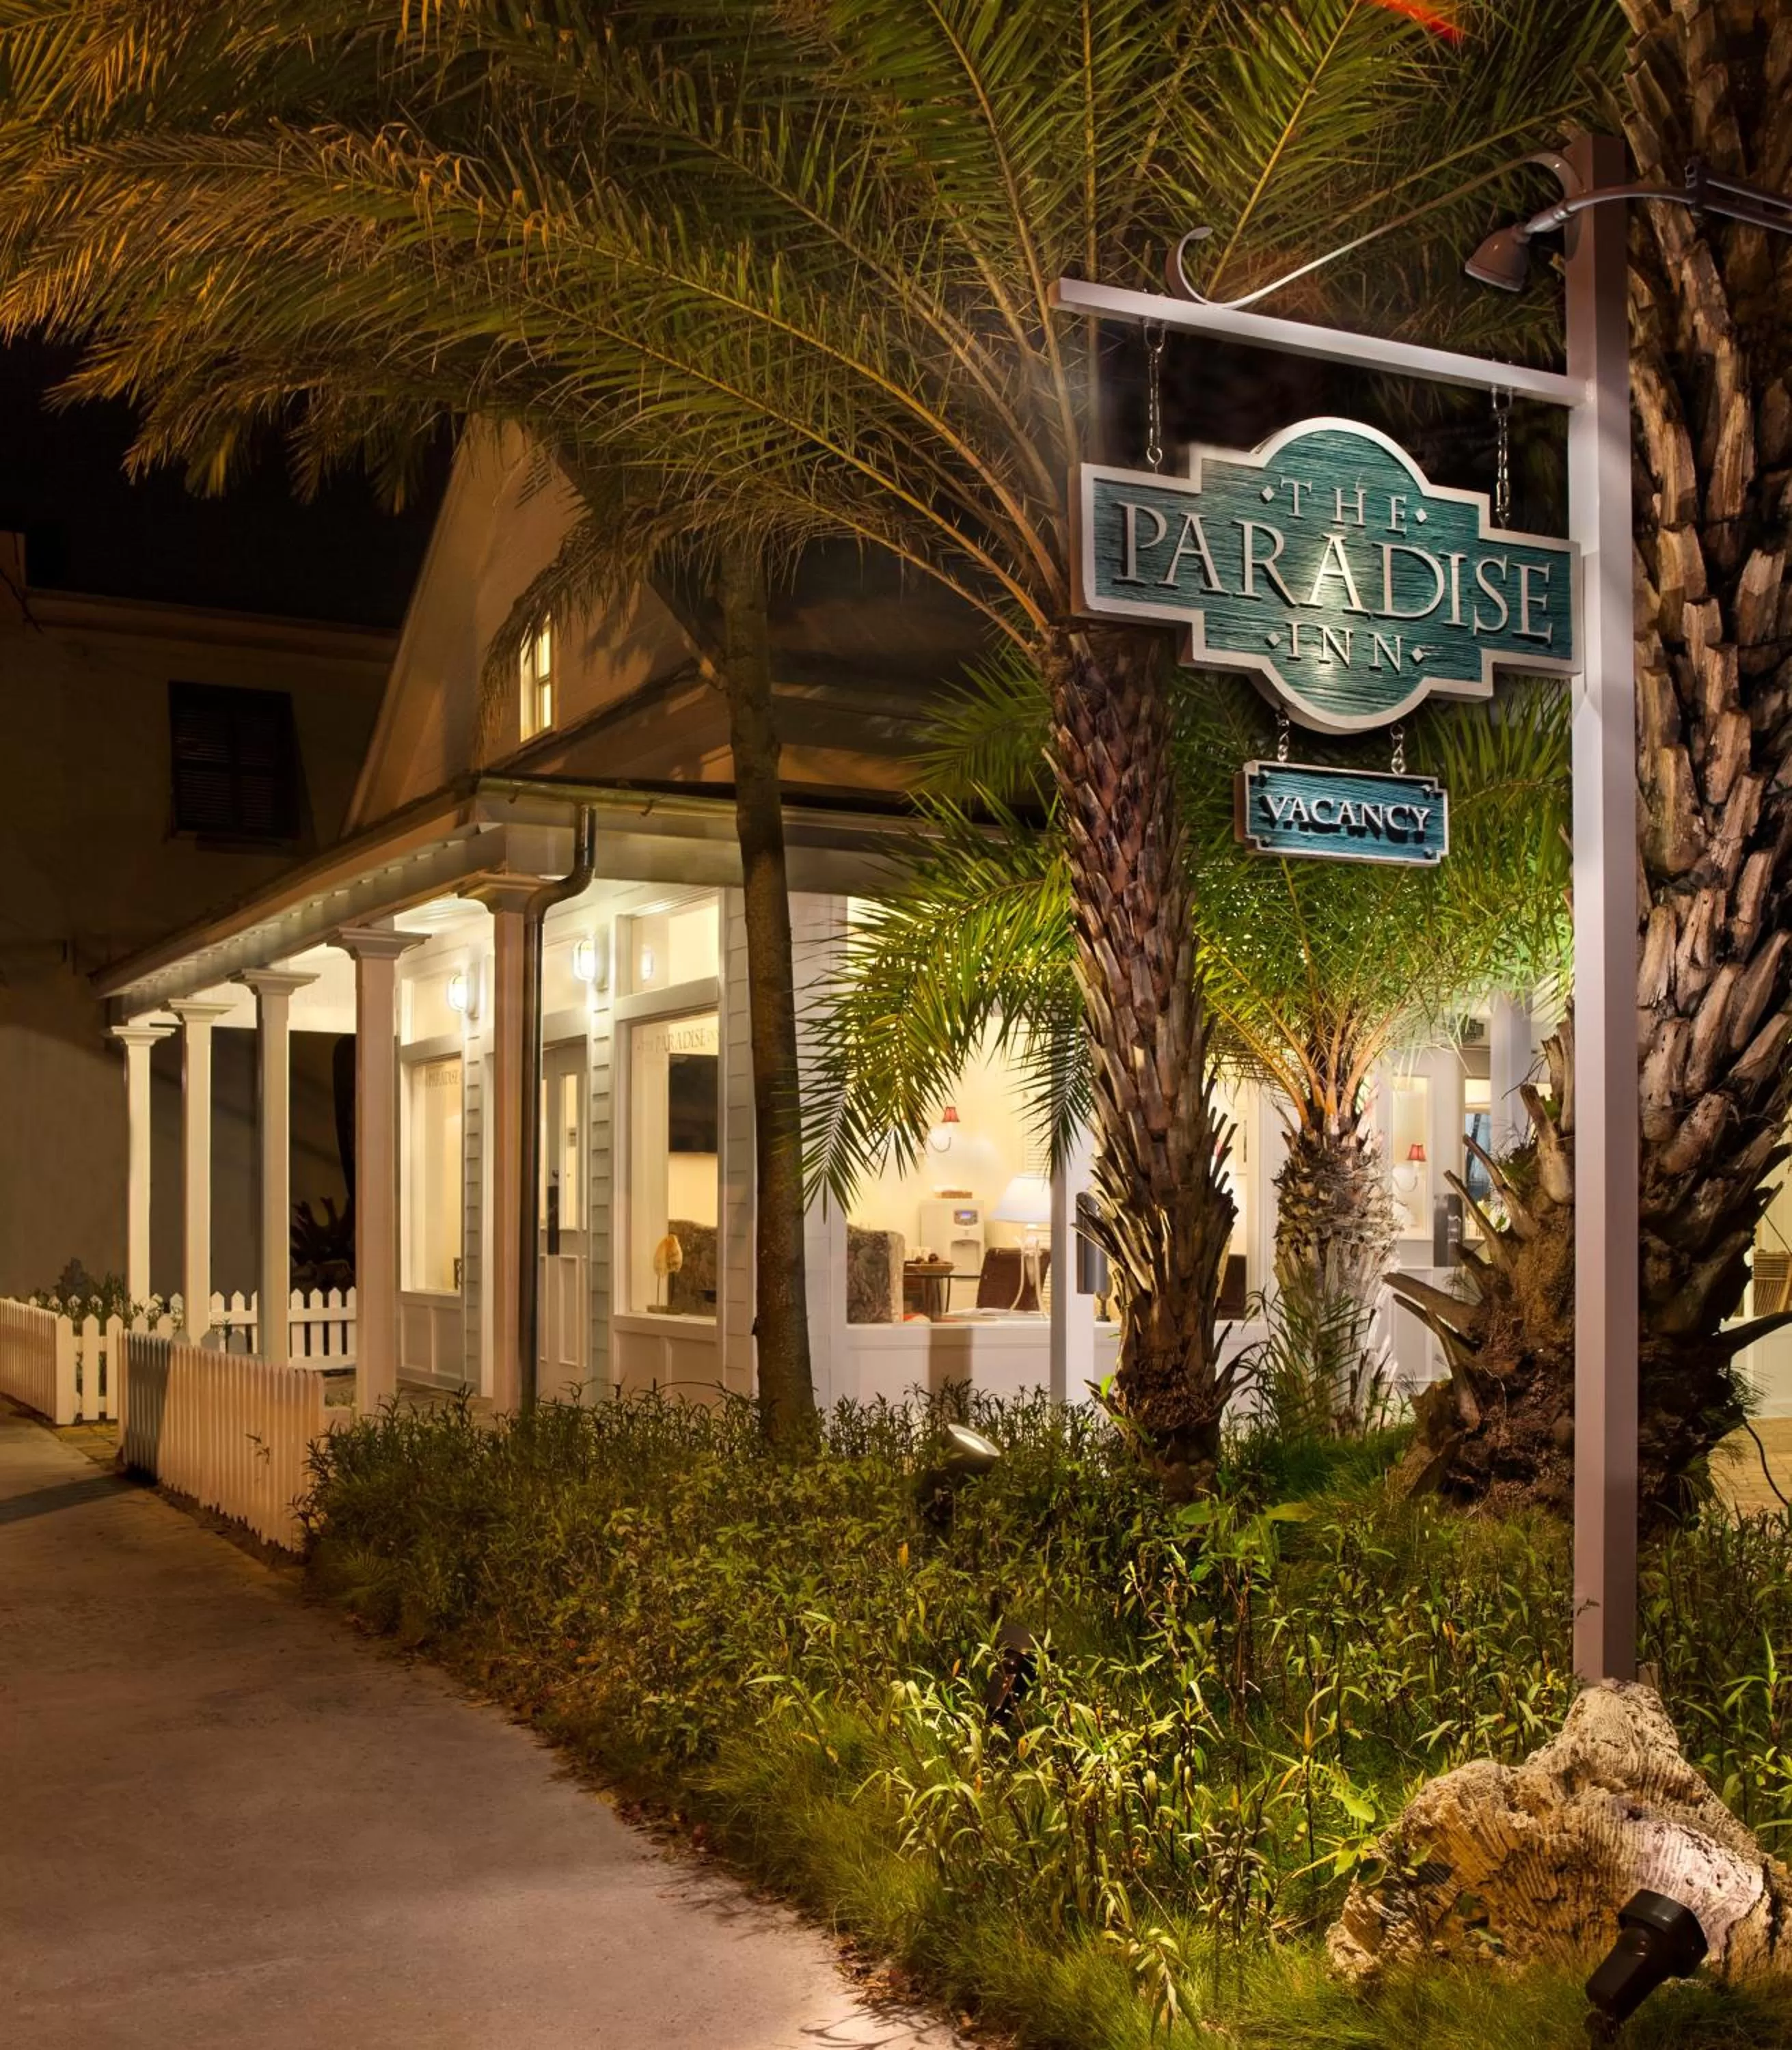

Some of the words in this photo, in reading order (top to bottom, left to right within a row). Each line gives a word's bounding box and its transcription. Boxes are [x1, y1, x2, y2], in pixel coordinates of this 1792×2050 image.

[1279, 478, 1409, 536] THE
[1113, 502, 1553, 644] PARADISE
[1286, 623, 1404, 674] INN
[1264, 795, 1431, 835] VACANCY
